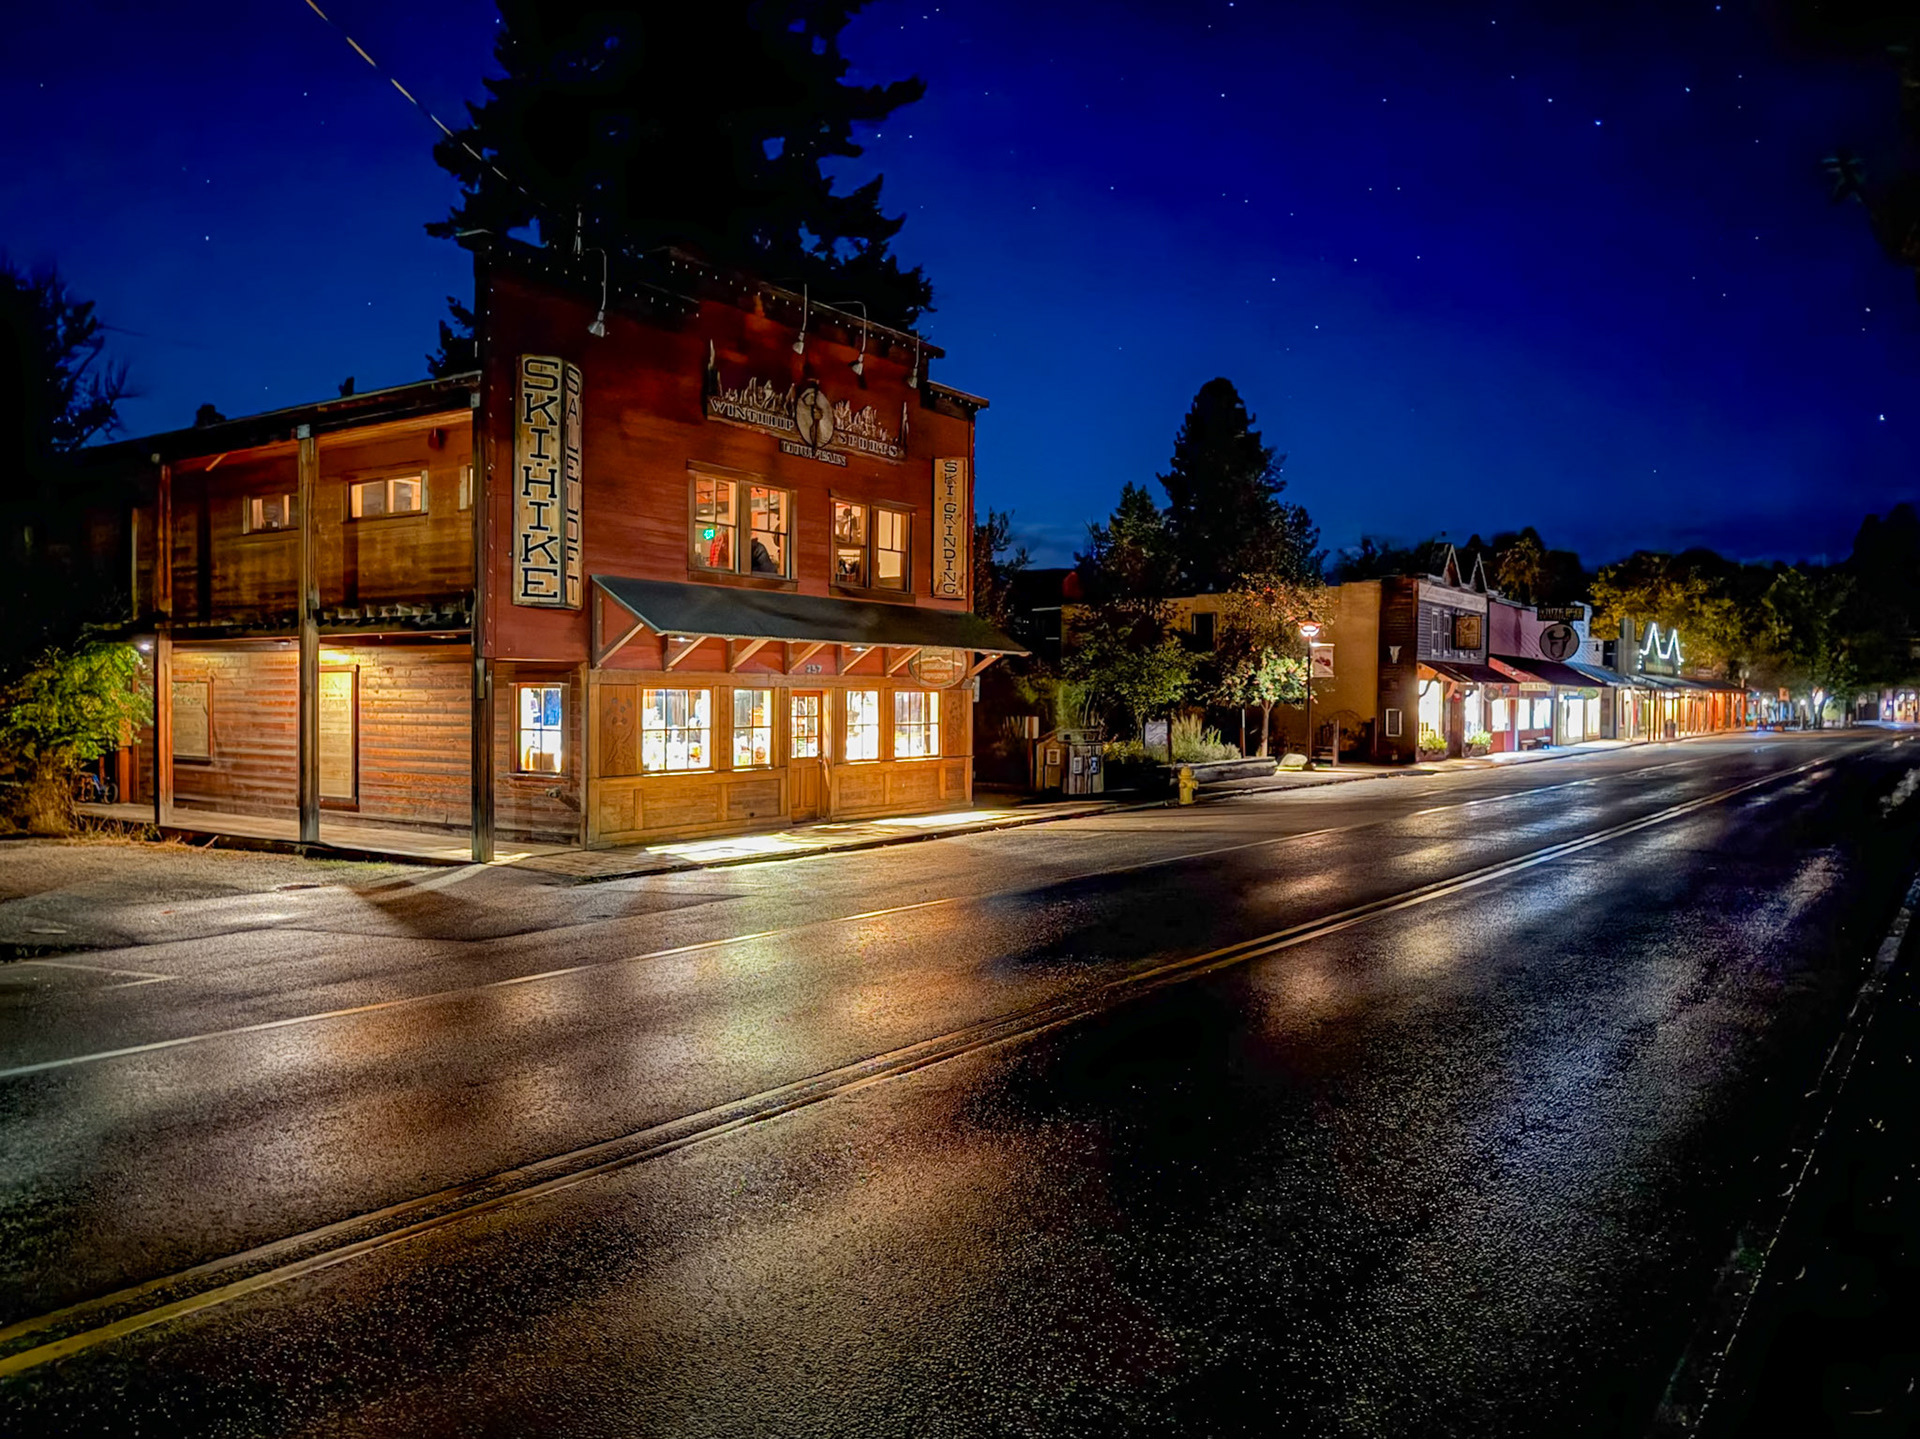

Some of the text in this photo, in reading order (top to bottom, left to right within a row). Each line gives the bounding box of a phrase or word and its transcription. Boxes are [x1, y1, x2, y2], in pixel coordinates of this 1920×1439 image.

[710, 398, 795, 431] WINTHROP
[838, 431, 898, 457] SPORTS
[565, 362, 582, 601] SALE LOFT
[943, 462, 958, 595] SKI GRINDING
